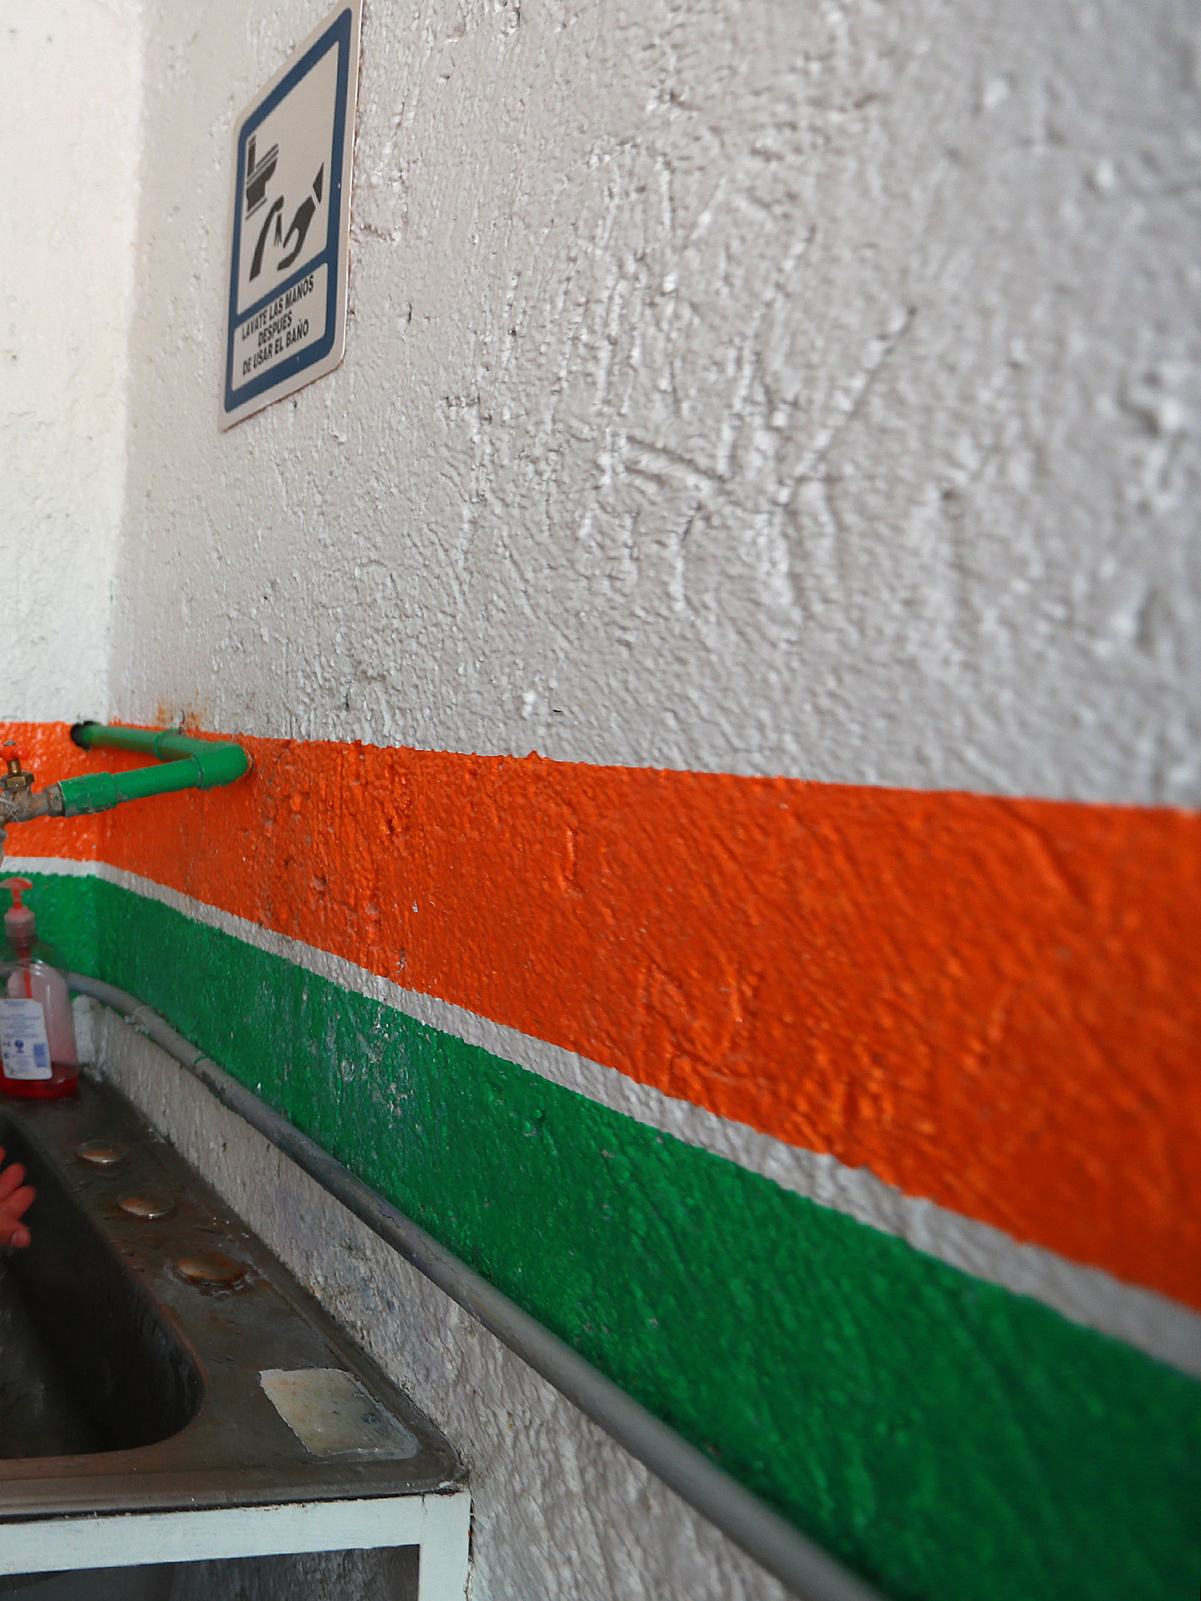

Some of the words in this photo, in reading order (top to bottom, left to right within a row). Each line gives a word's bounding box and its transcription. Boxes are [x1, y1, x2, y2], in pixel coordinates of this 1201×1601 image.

[242, 308, 268, 341] LAVATE
[269, 297, 283, 321] LAS
[285, 274, 314, 309] MANOS
[258, 310, 292, 347] DESPUES
[242, 357, 252, 376] DE
[253, 343, 273, 369] USAR
[274, 336, 284, 355] EL
